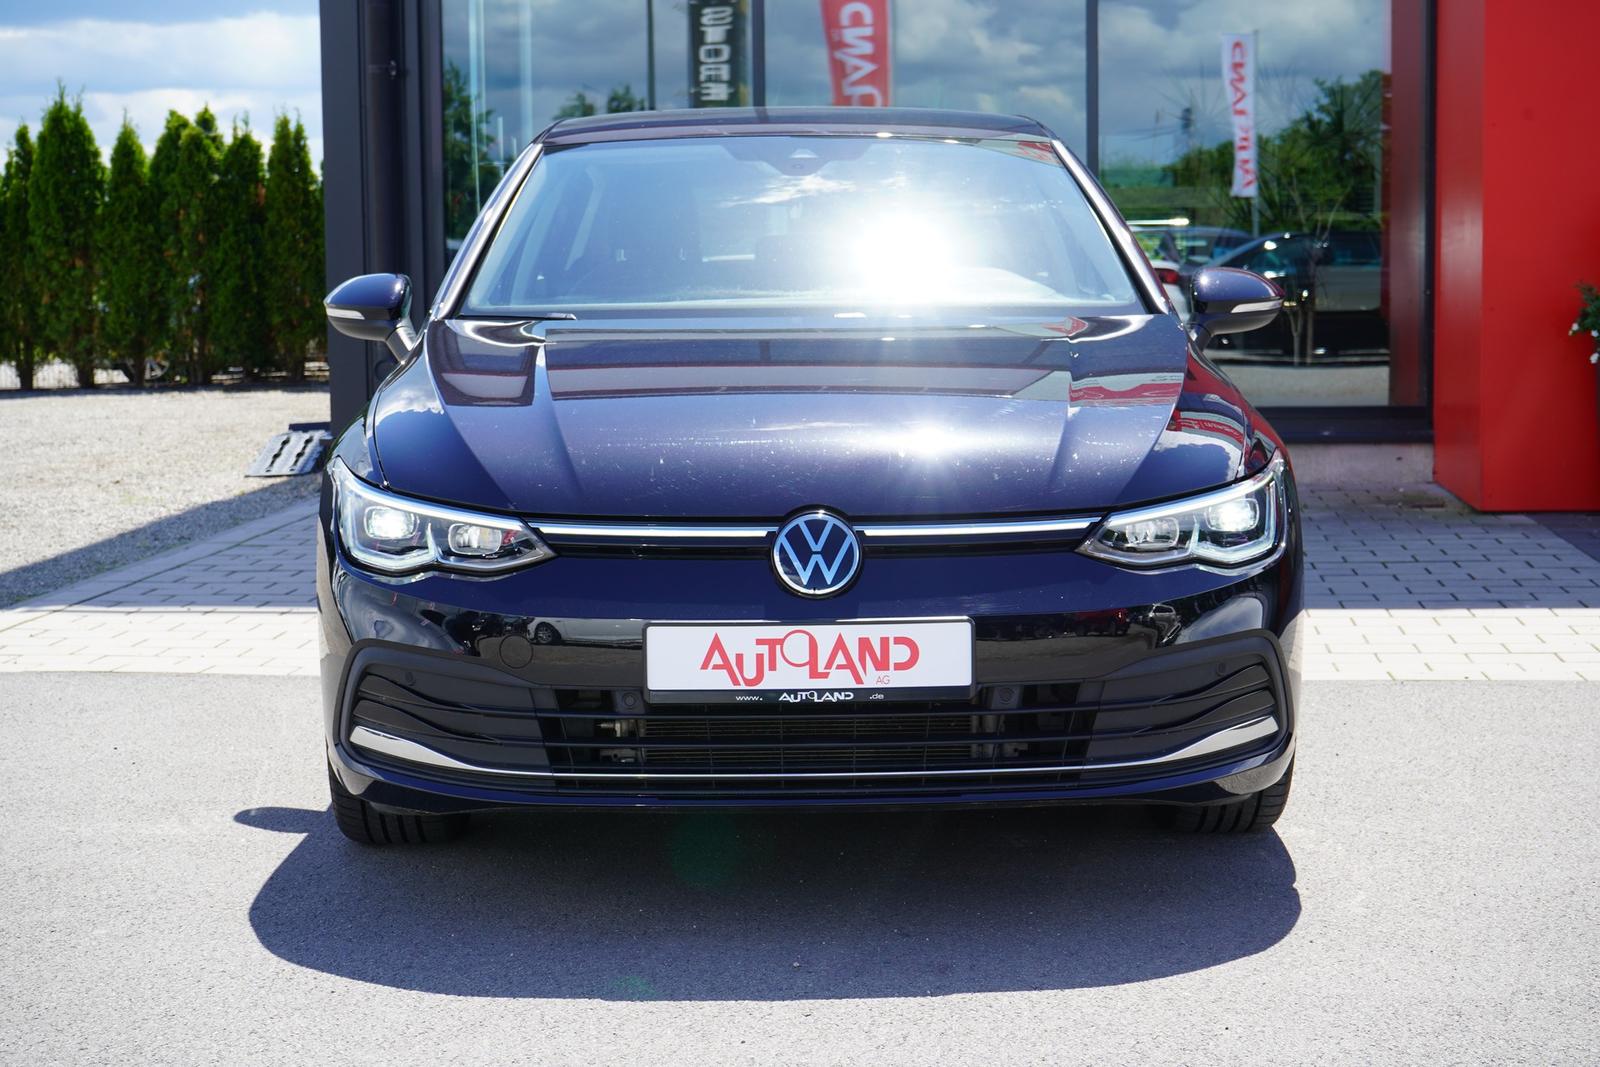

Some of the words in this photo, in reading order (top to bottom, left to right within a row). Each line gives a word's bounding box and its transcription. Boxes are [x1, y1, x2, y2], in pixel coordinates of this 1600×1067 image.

[700, 629, 920, 687] AUTOLAND
[876, 674, 890, 685] AG
[779, 690, 854, 703] AUTOLAND
